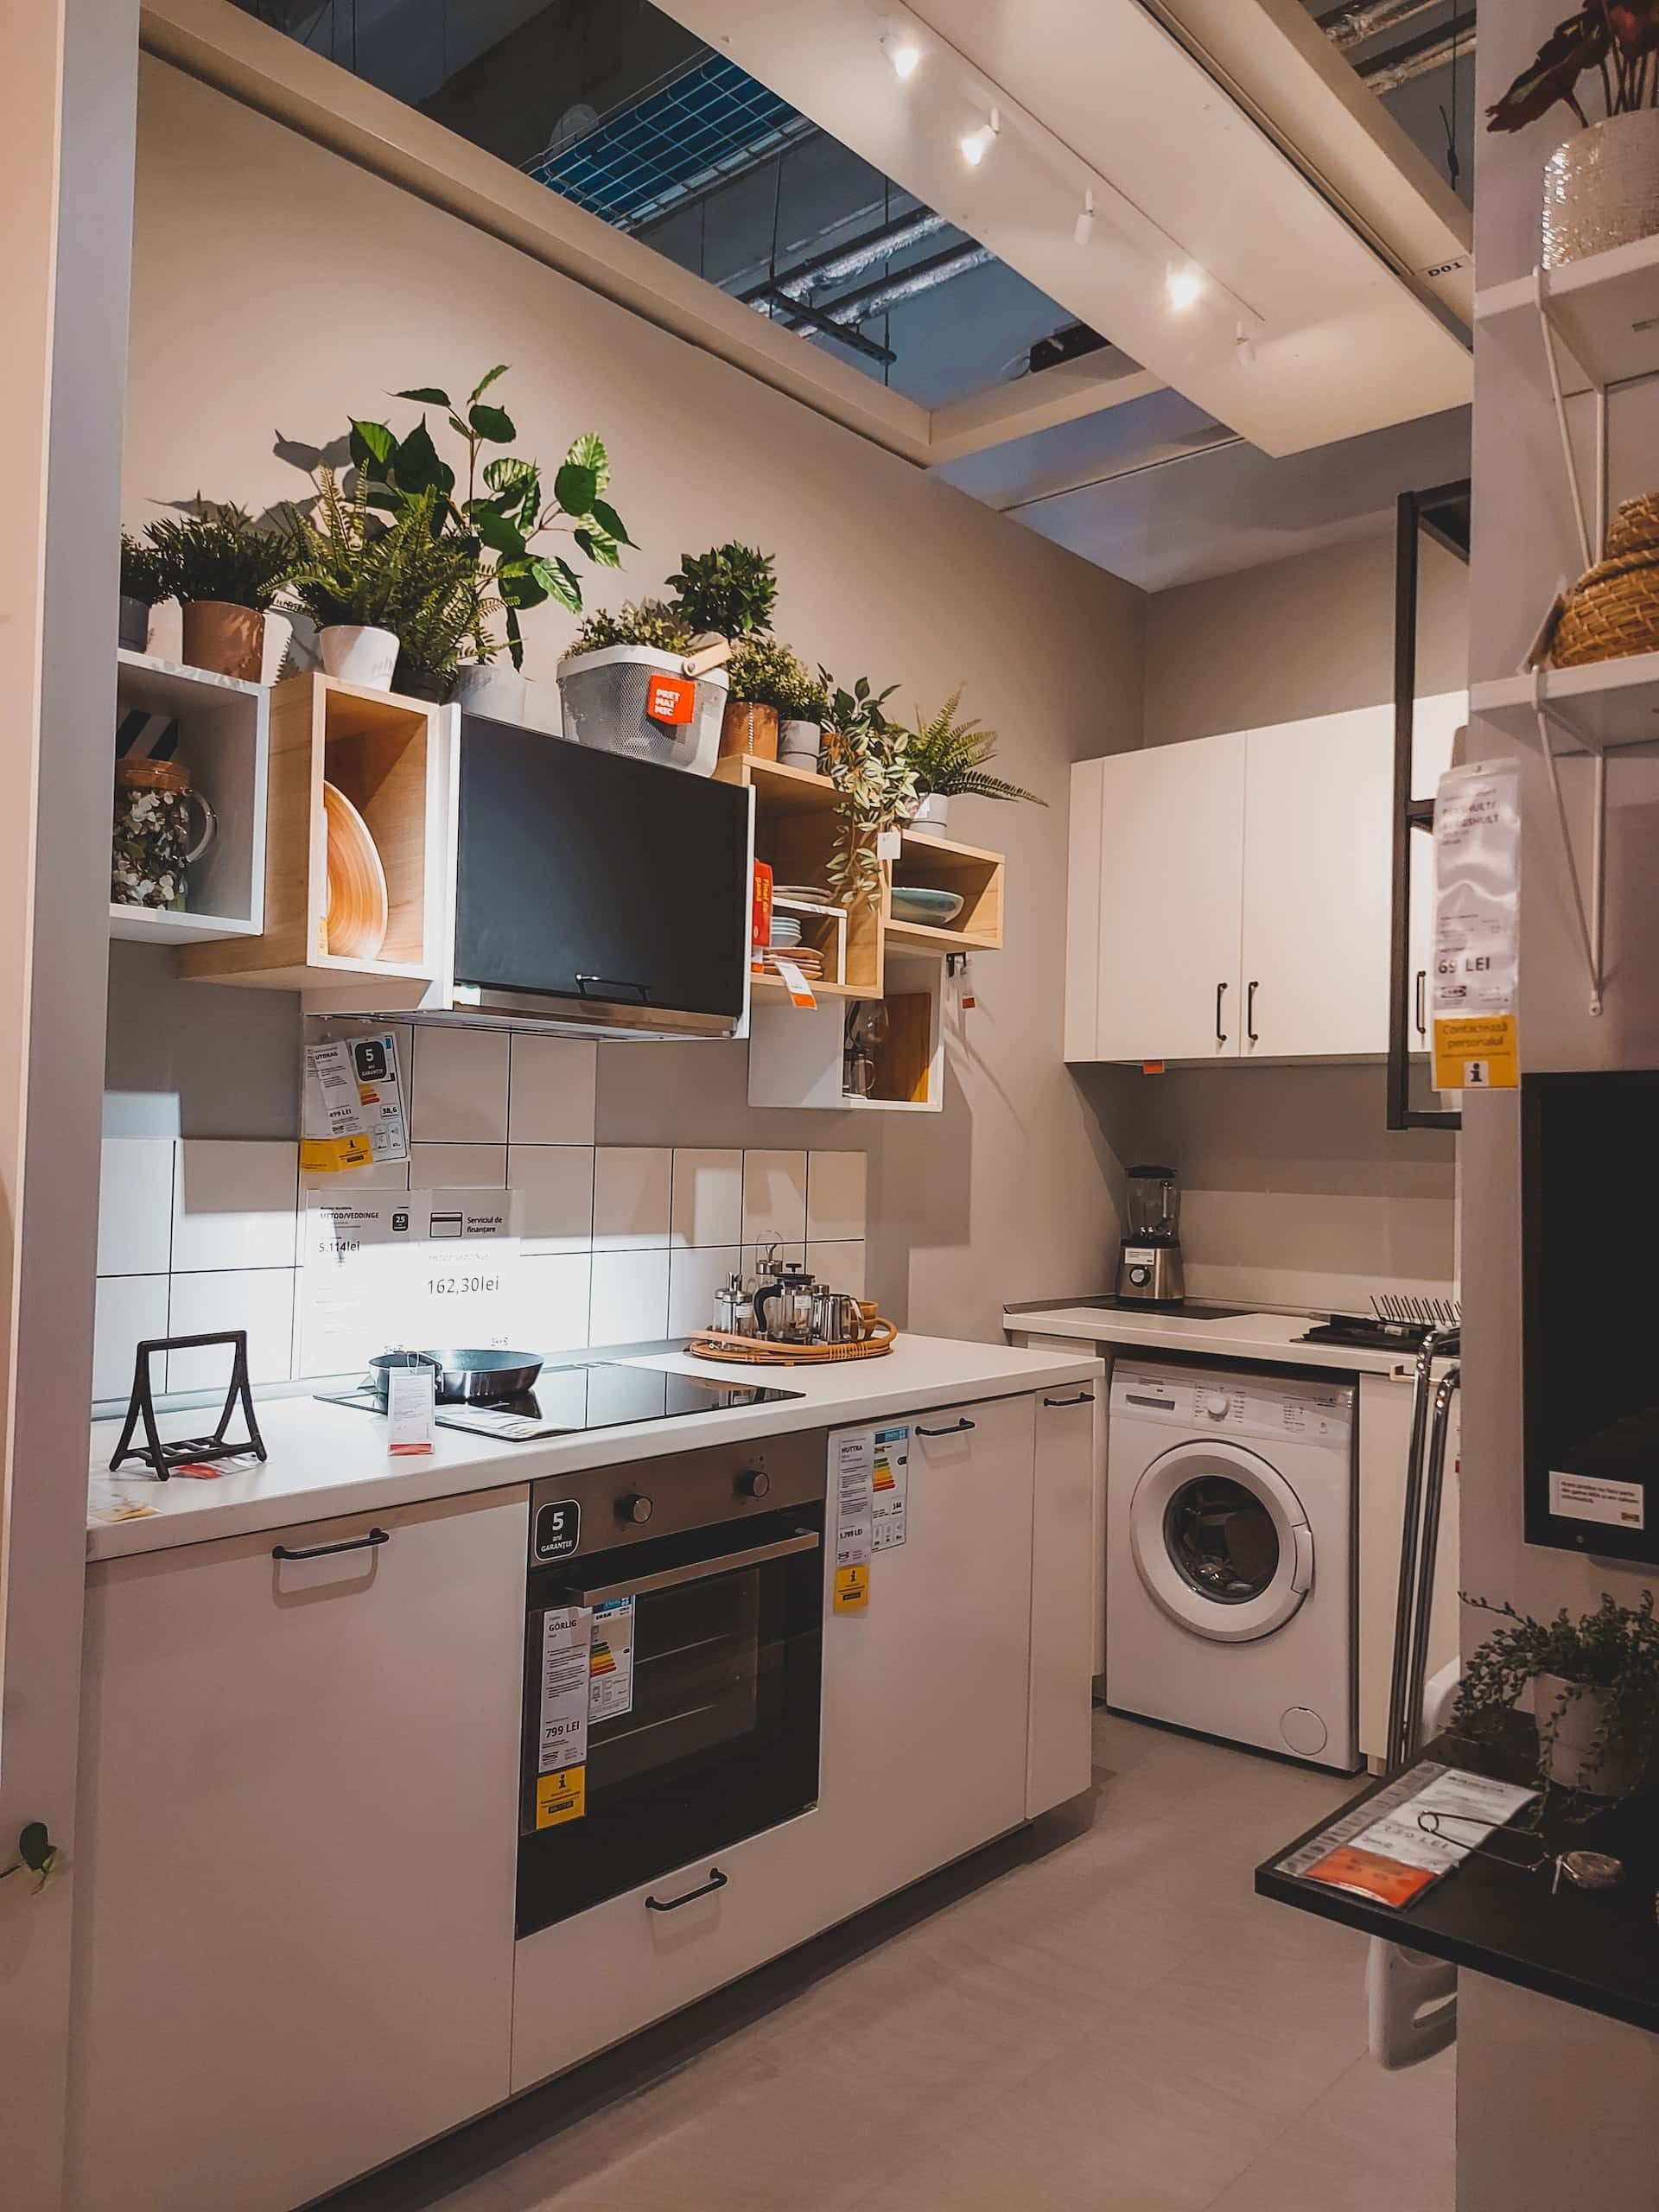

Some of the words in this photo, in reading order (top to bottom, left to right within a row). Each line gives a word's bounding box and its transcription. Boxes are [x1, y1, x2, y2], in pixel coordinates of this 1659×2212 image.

[1465, 956, 1491, 972] LEI
[365, 1048, 374, 1062] 5
[467, 1216, 493, 1224] Serviciul
[552, 1511, 564, 1531] 5
[541, 1540, 573, 1553] GARANȚIE
[549, 1618, 577, 1632] GÖRLIG
[545, 1725, 564, 1738] 799
[566, 1720, 580, 1733] LEI
